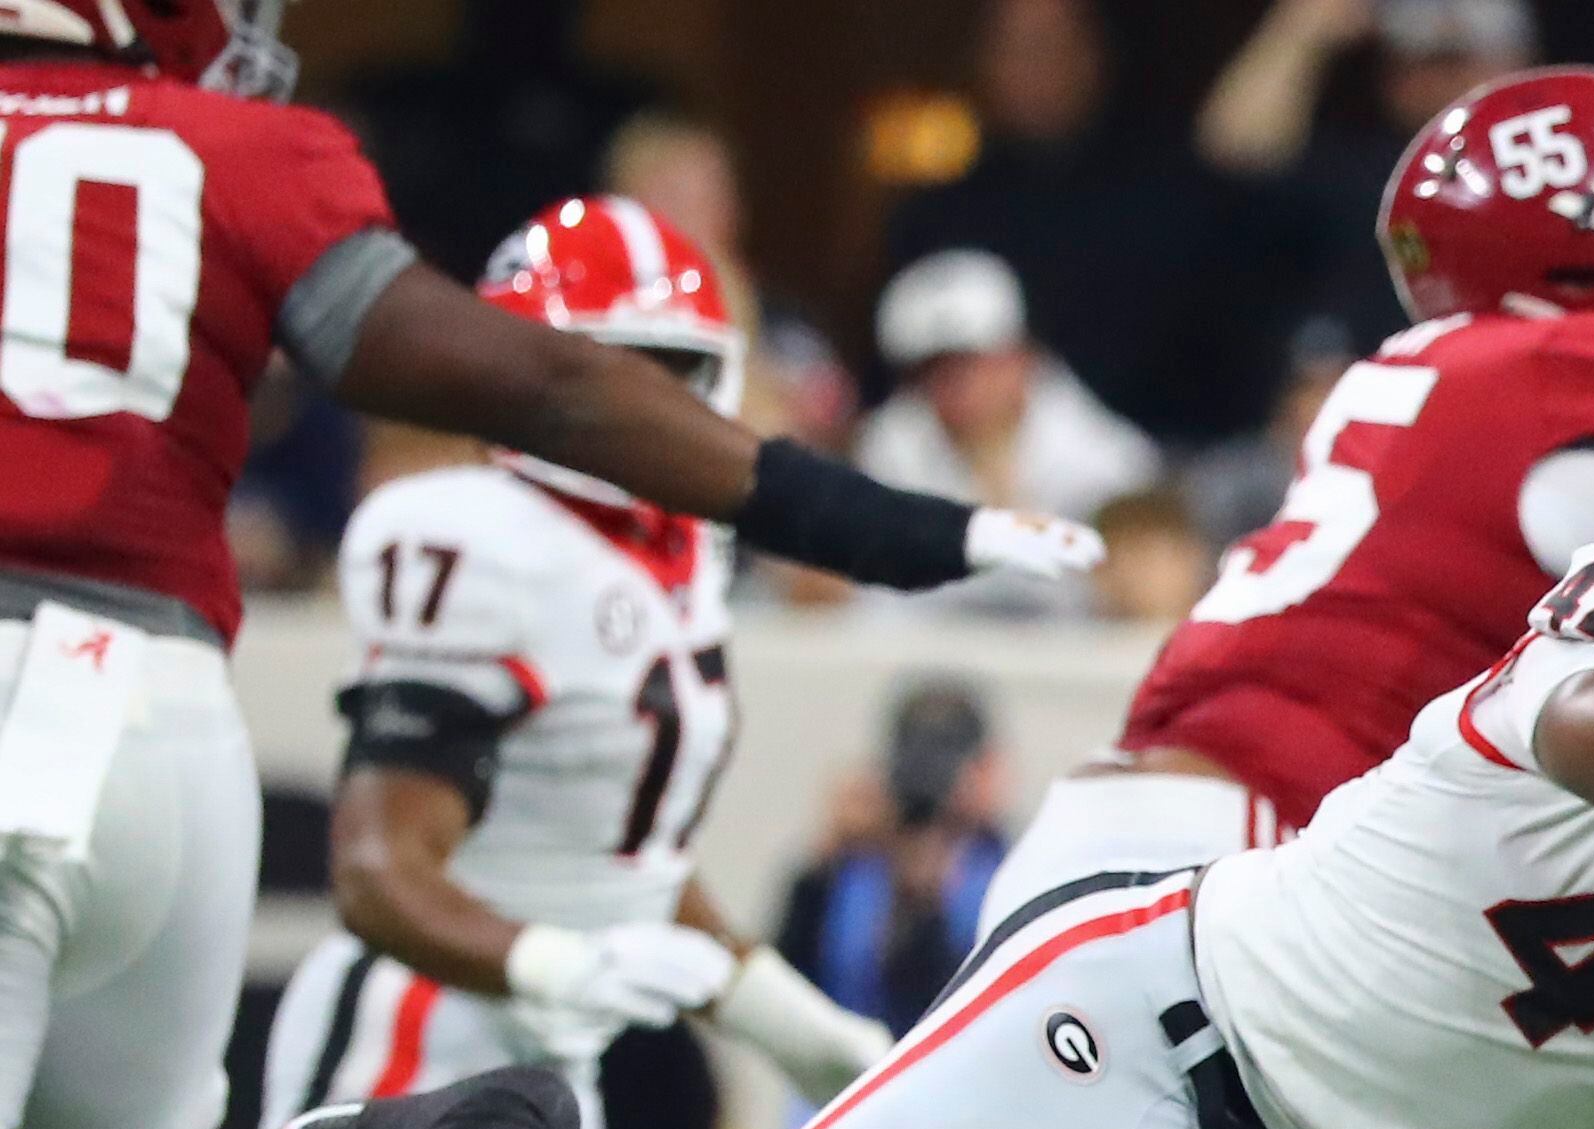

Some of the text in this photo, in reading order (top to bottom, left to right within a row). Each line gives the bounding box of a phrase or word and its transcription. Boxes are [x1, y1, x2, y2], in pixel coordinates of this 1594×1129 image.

[1489, 105, 1588, 199] 55
[0, 118, 205, 422] 0
[378, 543, 462, 627] 17
[1046, 1011, 1099, 1076] G
